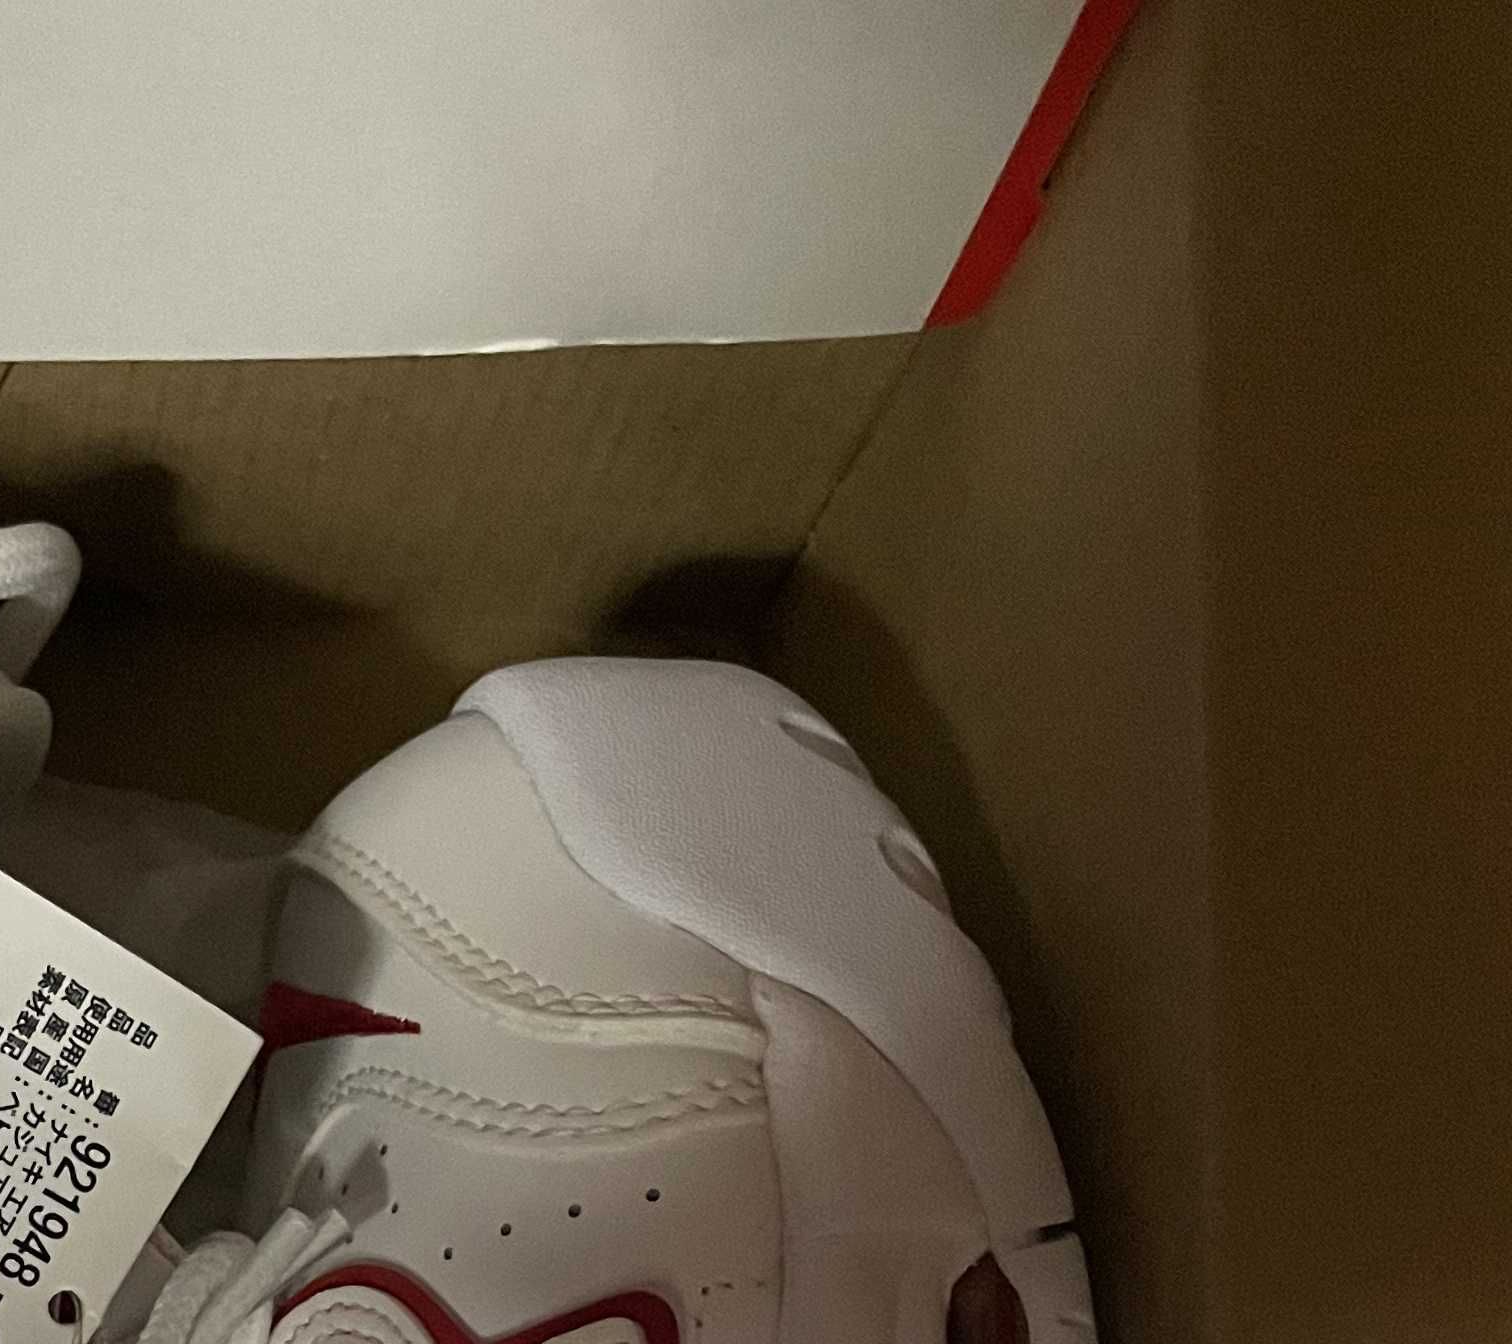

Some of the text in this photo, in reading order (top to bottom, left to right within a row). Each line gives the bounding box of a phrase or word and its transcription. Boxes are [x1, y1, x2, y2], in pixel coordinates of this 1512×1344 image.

[0, 964, 66, 1060] 素材表記
[21, 1118, 68, 1185] ナイキ
